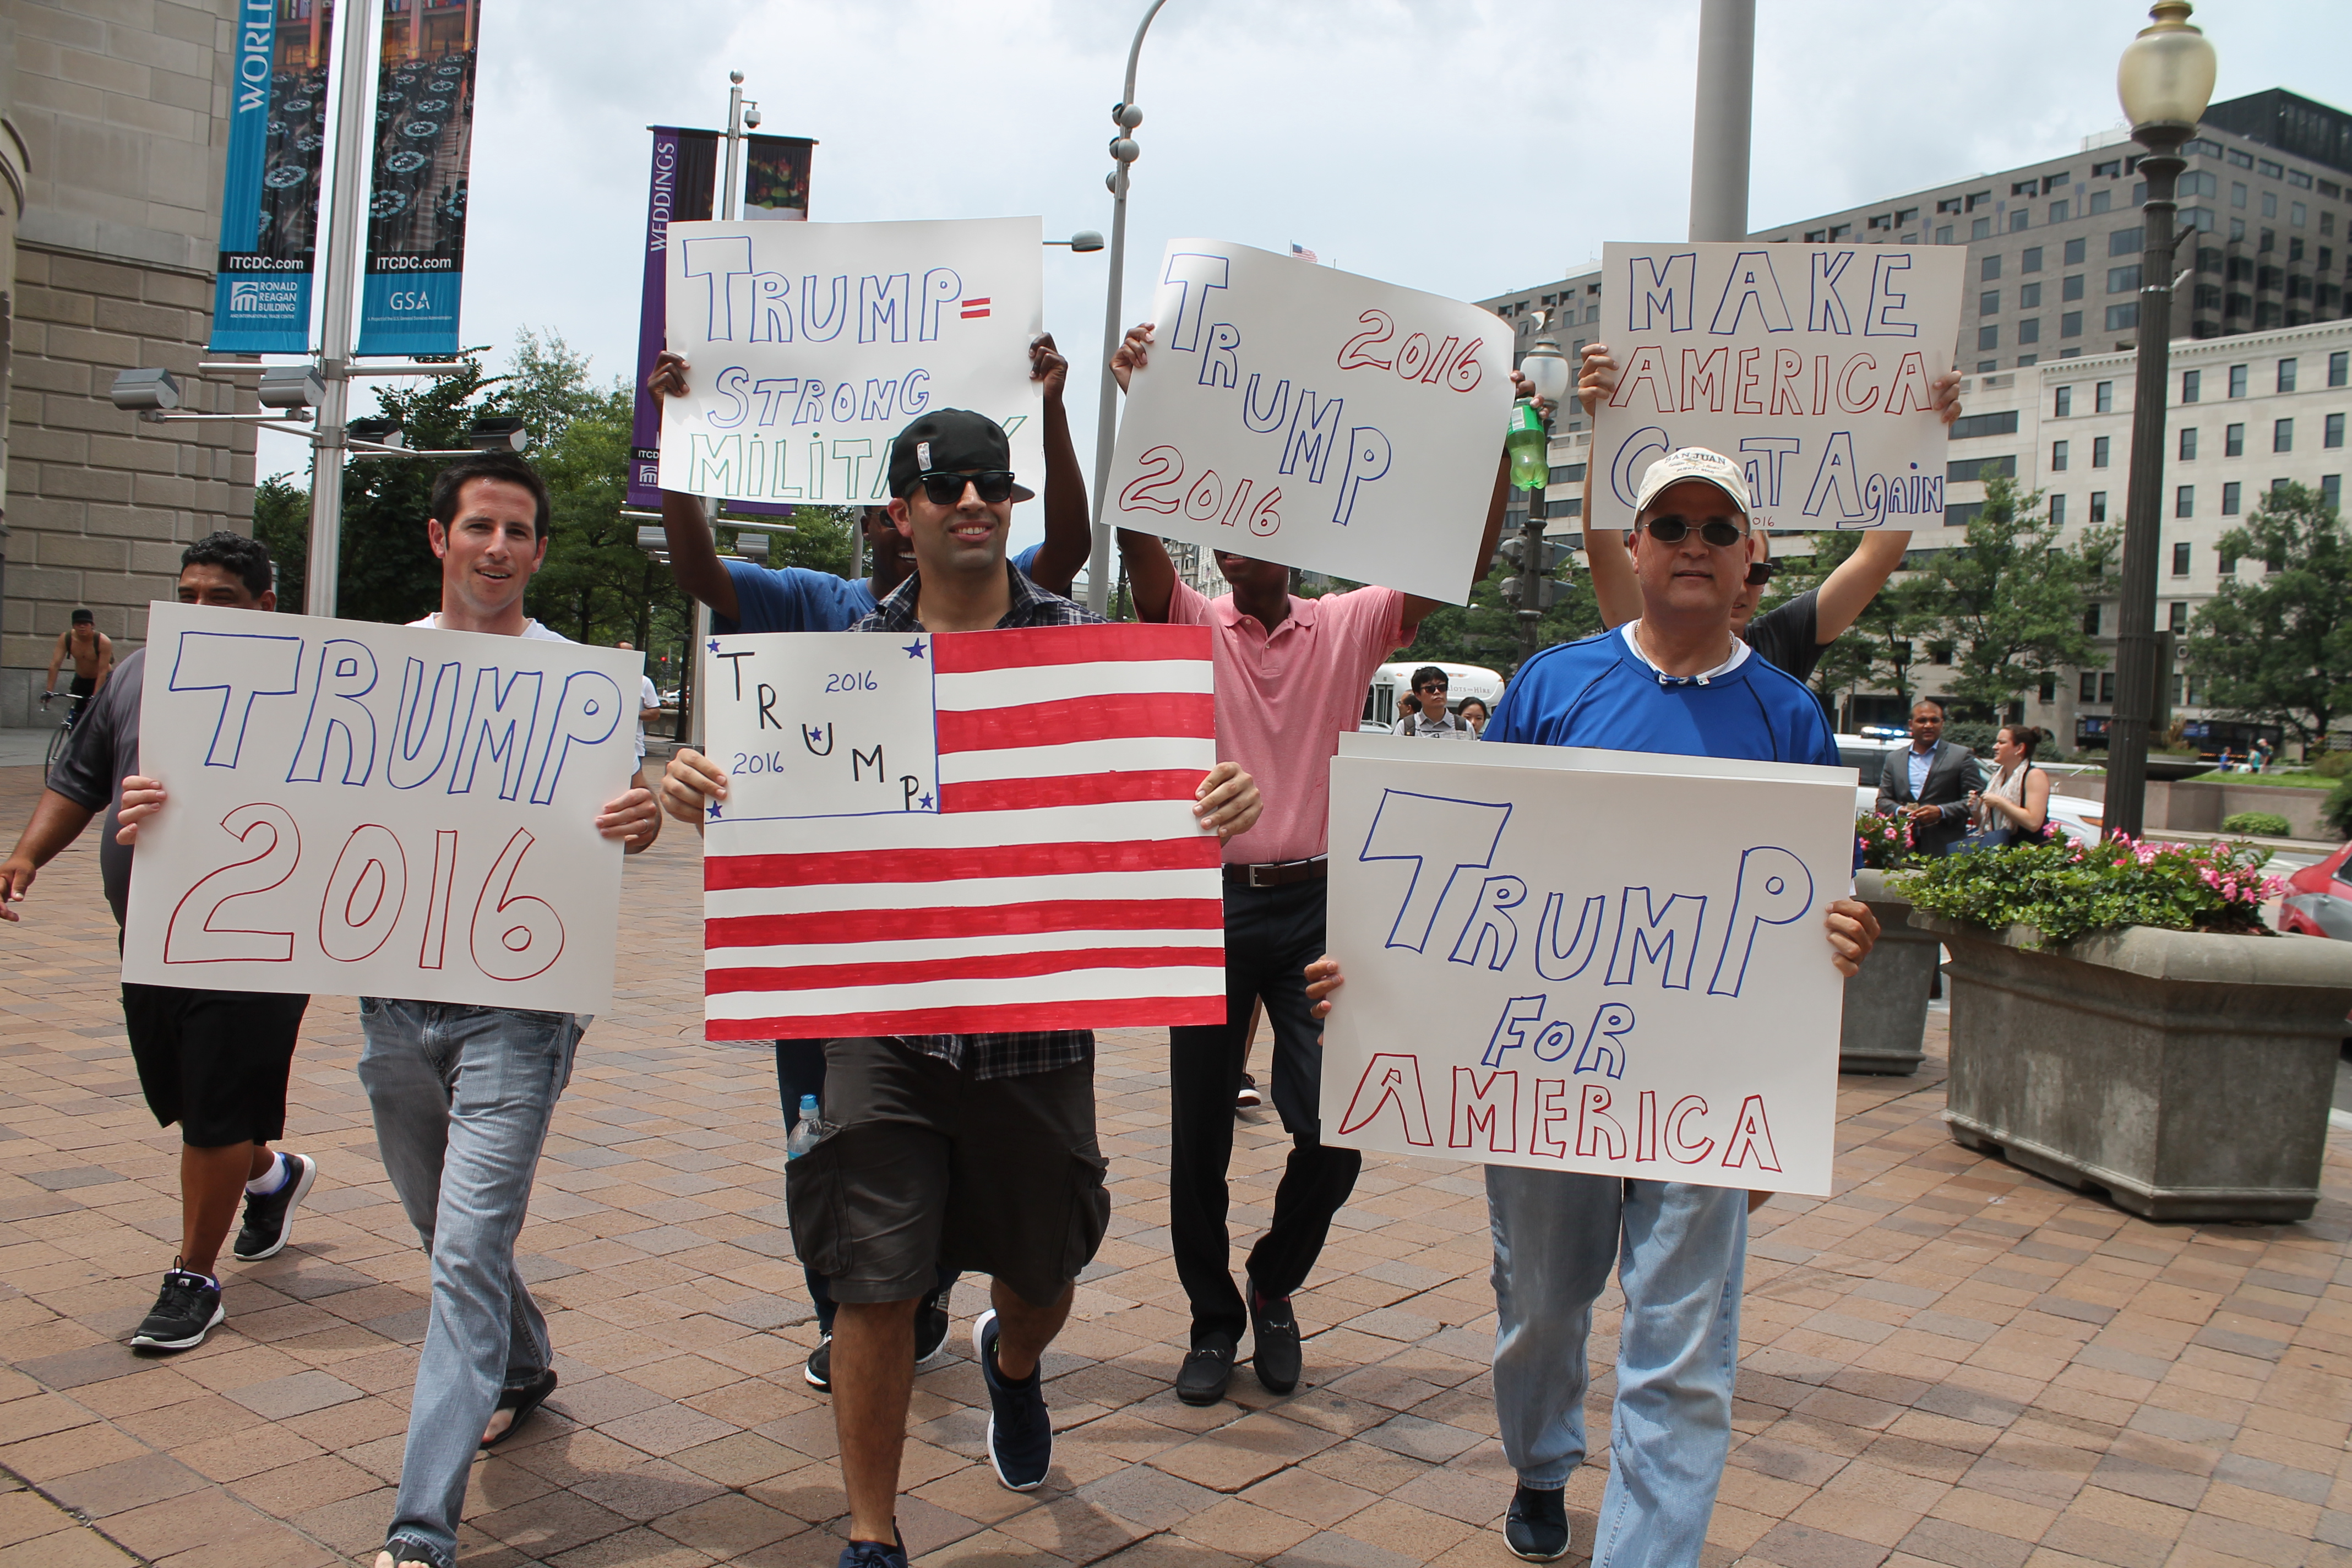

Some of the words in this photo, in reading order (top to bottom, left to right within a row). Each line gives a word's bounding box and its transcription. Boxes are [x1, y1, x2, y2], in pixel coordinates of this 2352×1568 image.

[650, 143, 674, 252] WEDDINGS
[230, 256, 303, 270] ITCDC.com
[260, 281, 297, 291] RONALD
[377, 256, 451, 270] ITCDC.com
[1628, 251, 1918, 337] MAKE
[258, 303, 296, 312] BUILDING
[259, 292, 297, 302] REAGAN
[390, 291, 431, 311] GSA
[1337, 308, 1483, 393] 2016
[1609, 346, 1933, 416] AMERICA
[707, 366, 930, 428] STRONG
[1164, 253, 1392, 526] TRUMP
[639, 450, 660, 459] ITCD
[1664, 452, 1690, 464] SAN
[1692, 453, 1727, 466] JUAN
[1119, 445, 1282, 537] 2016
[1752, 516, 1775, 527] 016
[825, 670, 878, 693] 2016
[168, 631, 623, 805] TRUMP
[731, 750, 785, 776] 2016
[164, 802, 565, 982] 2016
[1358, 788, 1814, 998] TRUMP
[1480, 993, 1635, 1080] FOR
[1338, 1052, 1783, 1173] AMERICA
